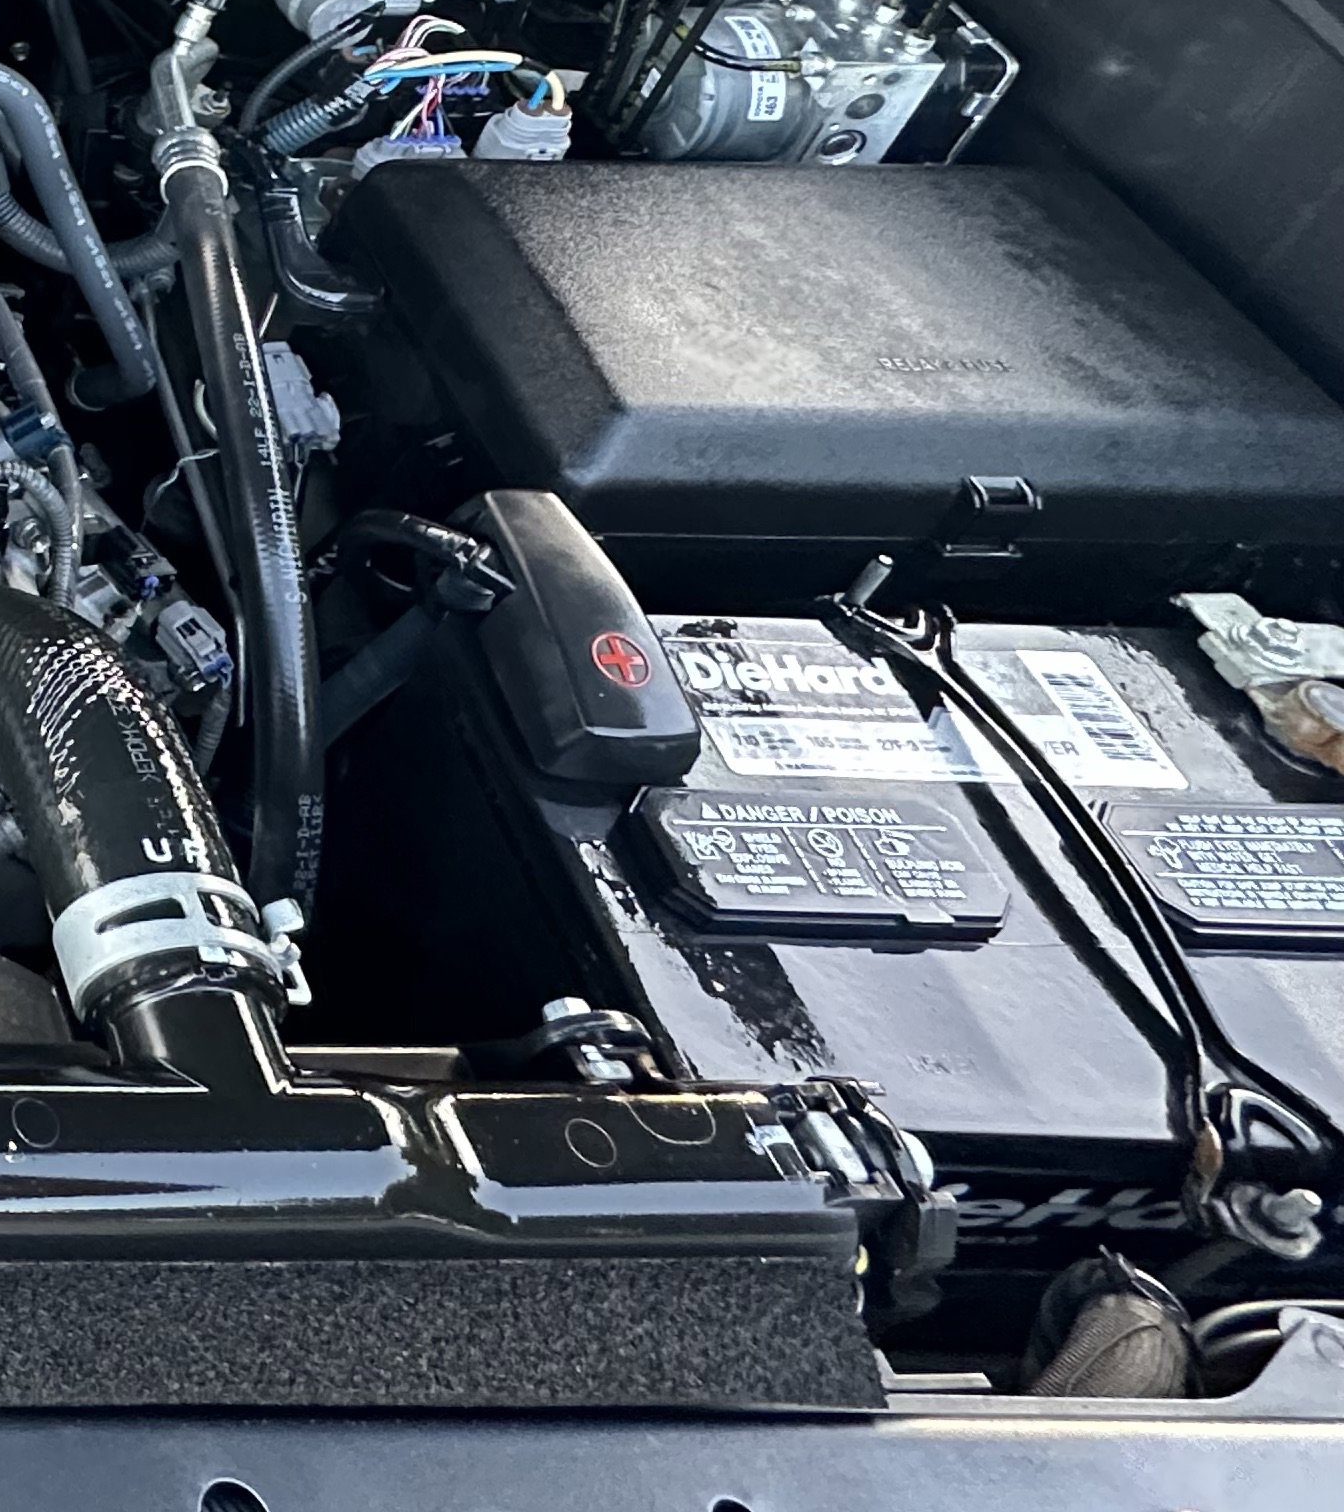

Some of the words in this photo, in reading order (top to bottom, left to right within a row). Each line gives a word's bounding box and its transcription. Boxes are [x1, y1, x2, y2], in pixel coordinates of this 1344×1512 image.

[764, 96, 778, 116] 463
[878, 357, 943, 372] RELAY
[678, 650, 904, 695] DieHard
[717, 804, 810, 823] DANGER
[822, 806, 903, 824] POISON
